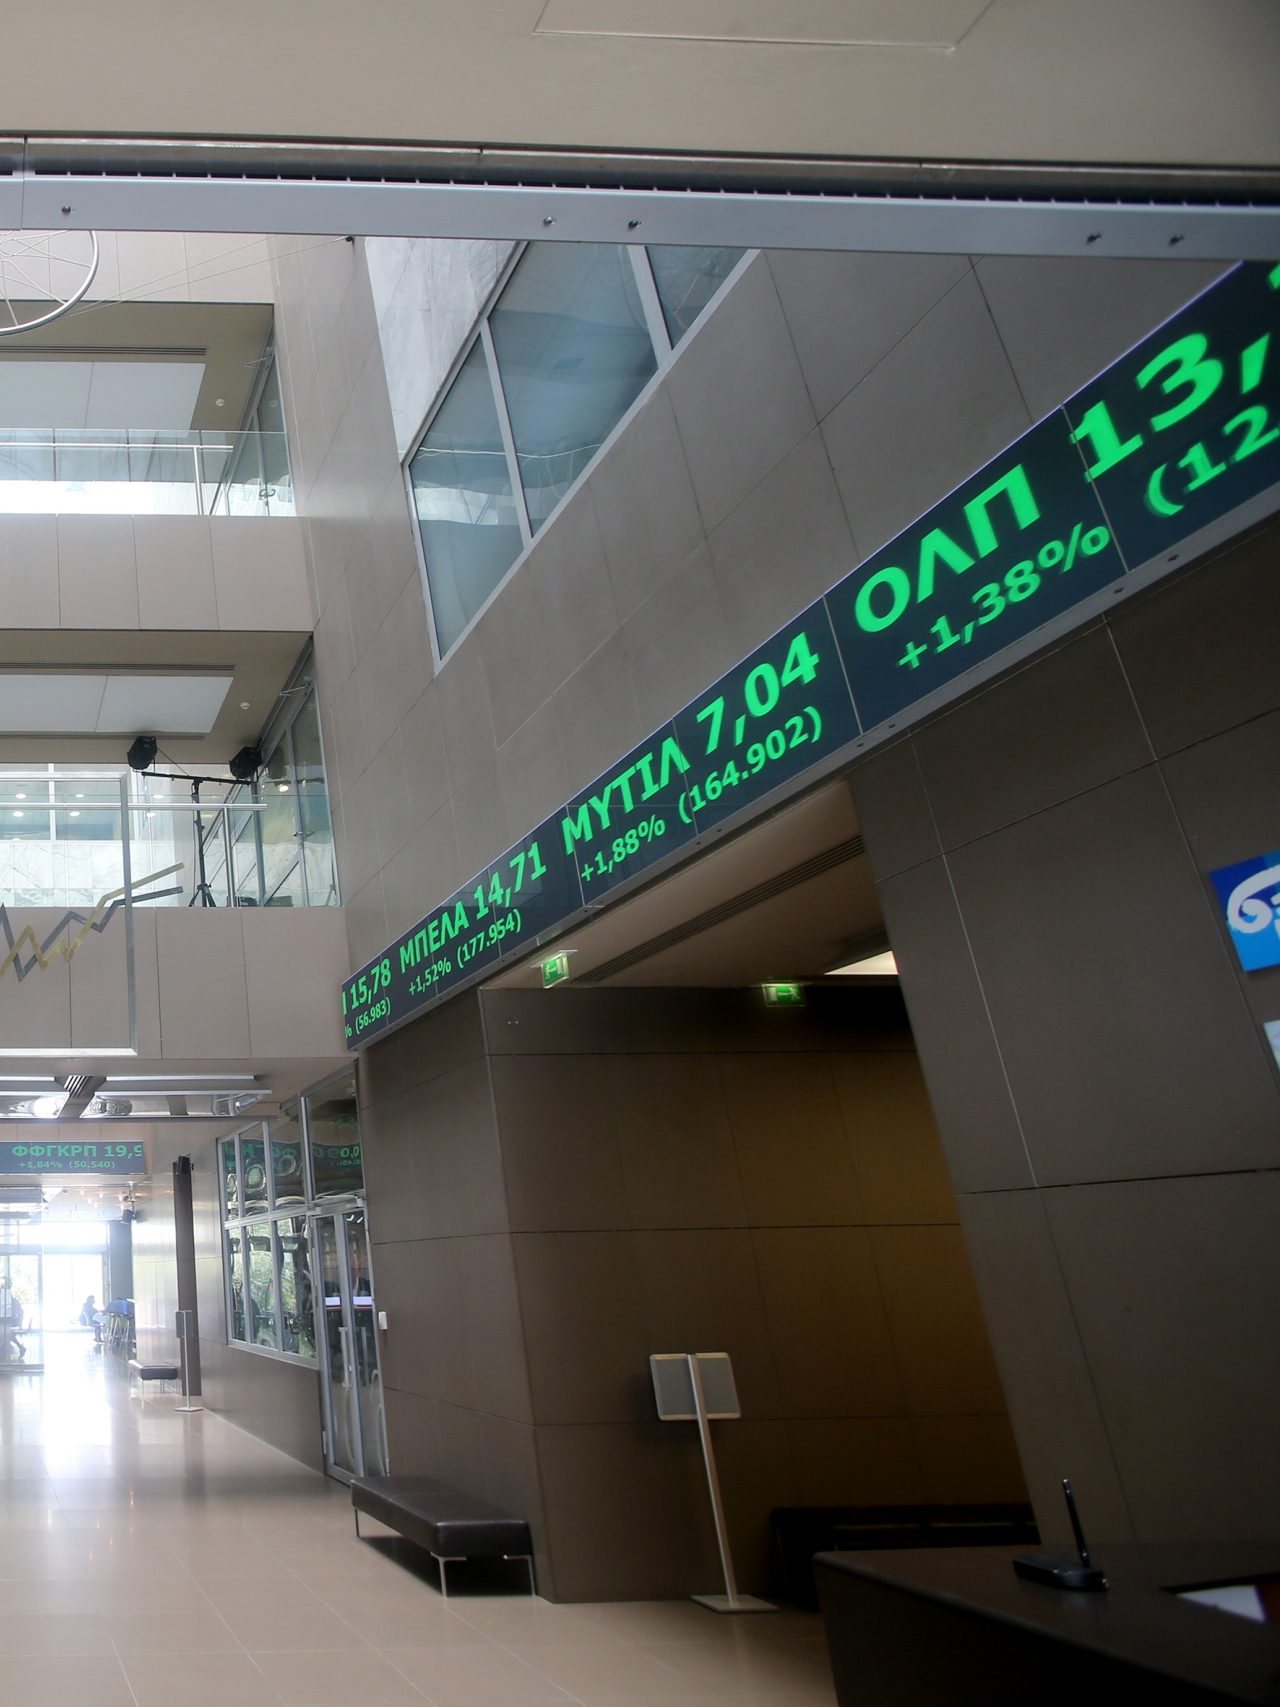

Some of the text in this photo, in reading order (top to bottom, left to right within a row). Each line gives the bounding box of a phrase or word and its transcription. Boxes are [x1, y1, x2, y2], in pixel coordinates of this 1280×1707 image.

[854, 264, 1280, 633] ΟΛΠ 13,
[897, 522, 1112, 669] +1,38%
[350, 631, 821, 1009] 15,78 ΜΠΕΛΑ 14,71 ΜΥΤΙΛ 7,04
[355, 997, 392, 1035] (56.983)
[408, 957, 452, 996] +1,52%
[457, 908, 522, 969] (177.954)
[580, 814, 666, 882] +1,88%
[678, 705, 823, 824] (164.902)
